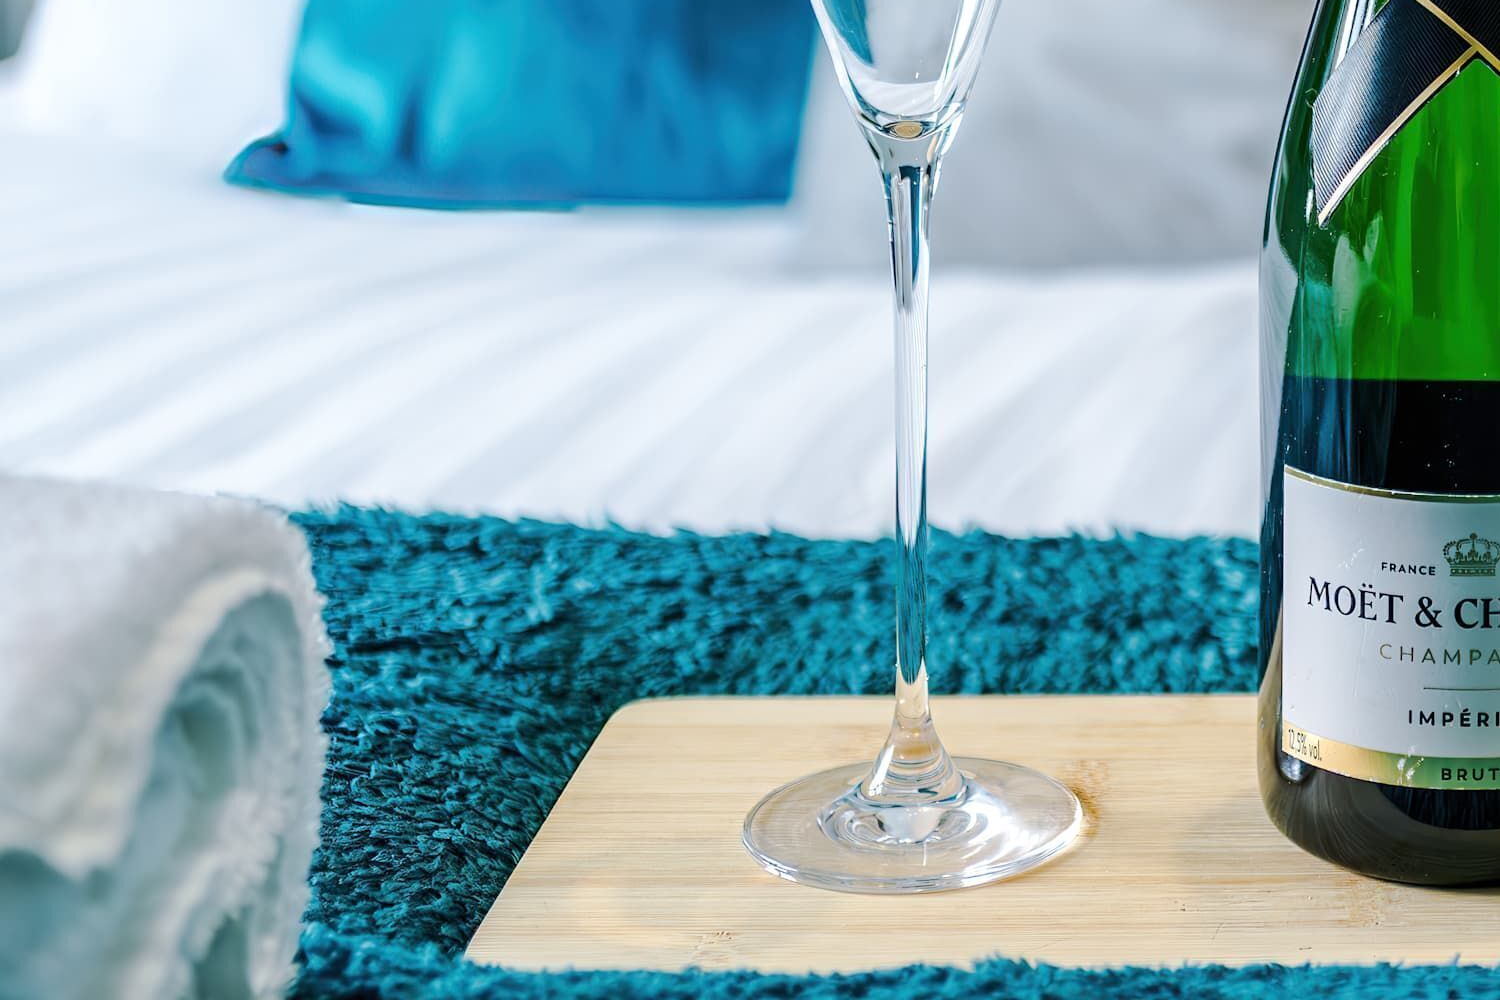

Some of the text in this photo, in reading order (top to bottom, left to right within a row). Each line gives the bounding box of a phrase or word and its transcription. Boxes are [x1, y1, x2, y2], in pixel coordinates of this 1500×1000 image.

[1381, 561, 1436, 576] FRANCE
[1306, 575, 1404, 624] MOËT
[1414, 596, 1443, 628] &
[1440, 766, 1500, 782] BRUT
